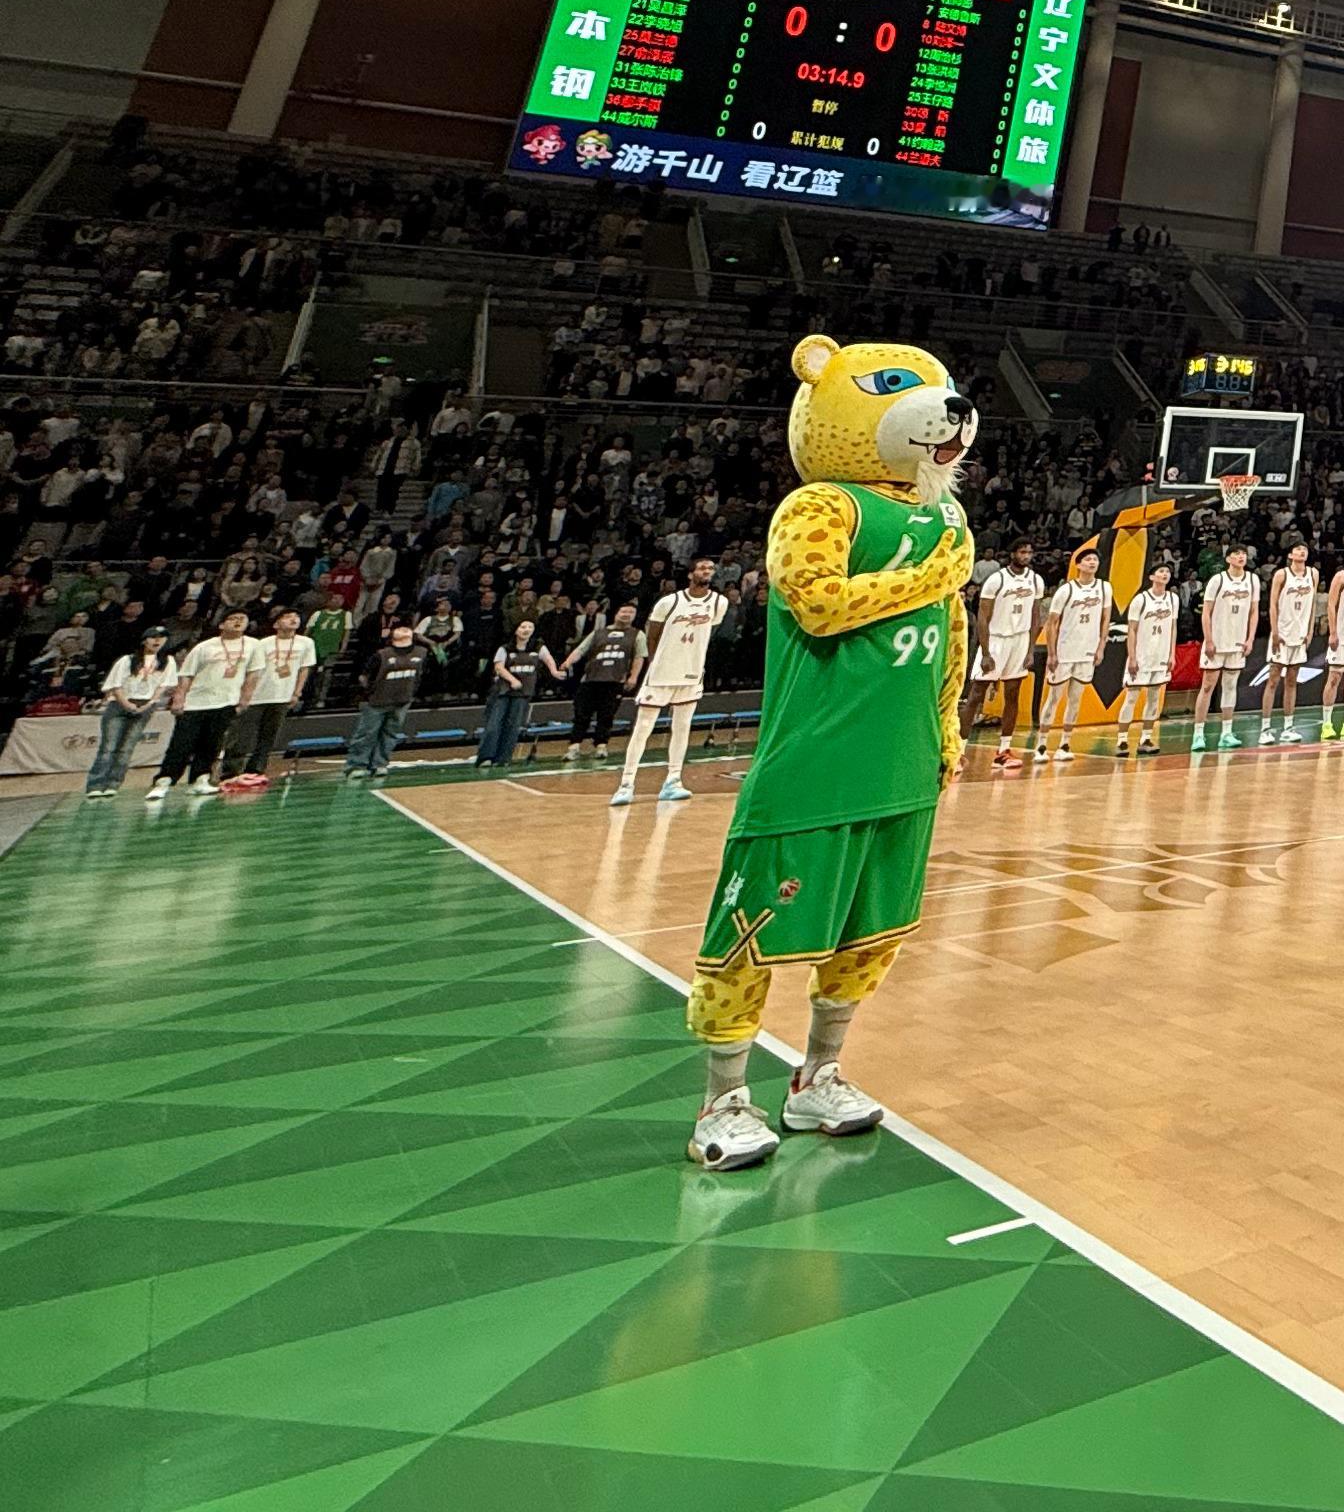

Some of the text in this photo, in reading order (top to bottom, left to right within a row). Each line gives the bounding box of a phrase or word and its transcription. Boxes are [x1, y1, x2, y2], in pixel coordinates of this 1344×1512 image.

[785, 6, 808, 36] 0
[875, 22, 897, 52] 0
[797, 62, 865, 88] 03:14.9
[752, 121, 767, 140] 0
[866, 137, 880, 156] 0
[610, 143, 845, 198] 游千山 看辽篮
[680, 631, 695, 644] 44
[892, 624, 940, 667] 99
